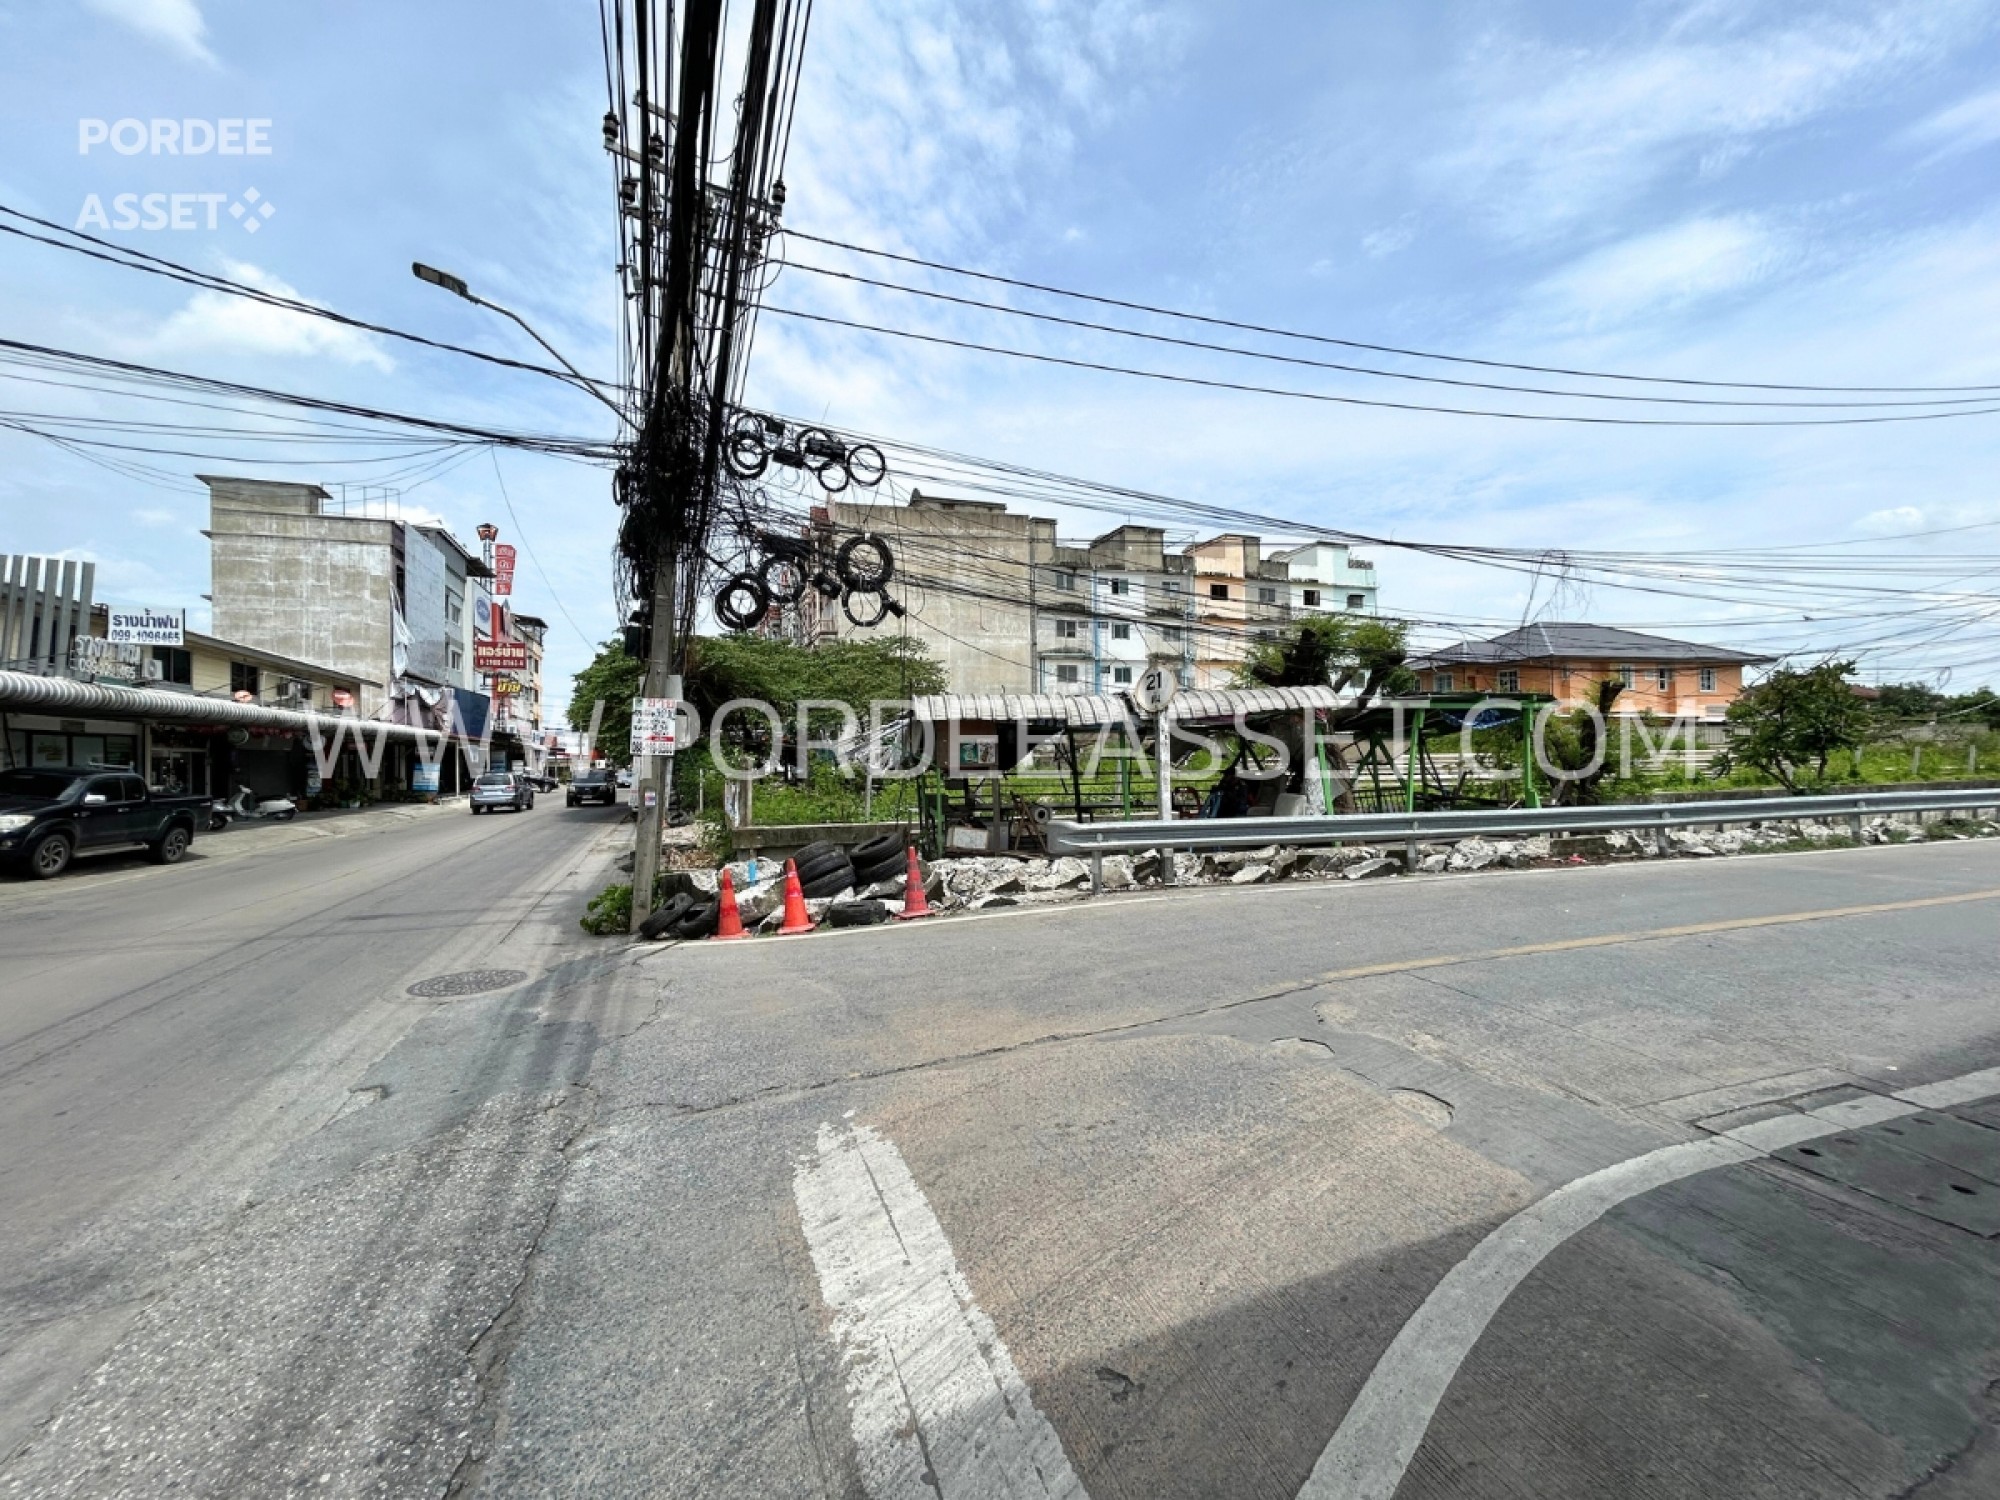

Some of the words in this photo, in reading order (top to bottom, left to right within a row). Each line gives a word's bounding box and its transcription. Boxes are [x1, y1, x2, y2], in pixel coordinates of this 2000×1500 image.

[112, 607, 180, 629] รางน้ำฝน
[1146, 671, 1162, 691] 21
